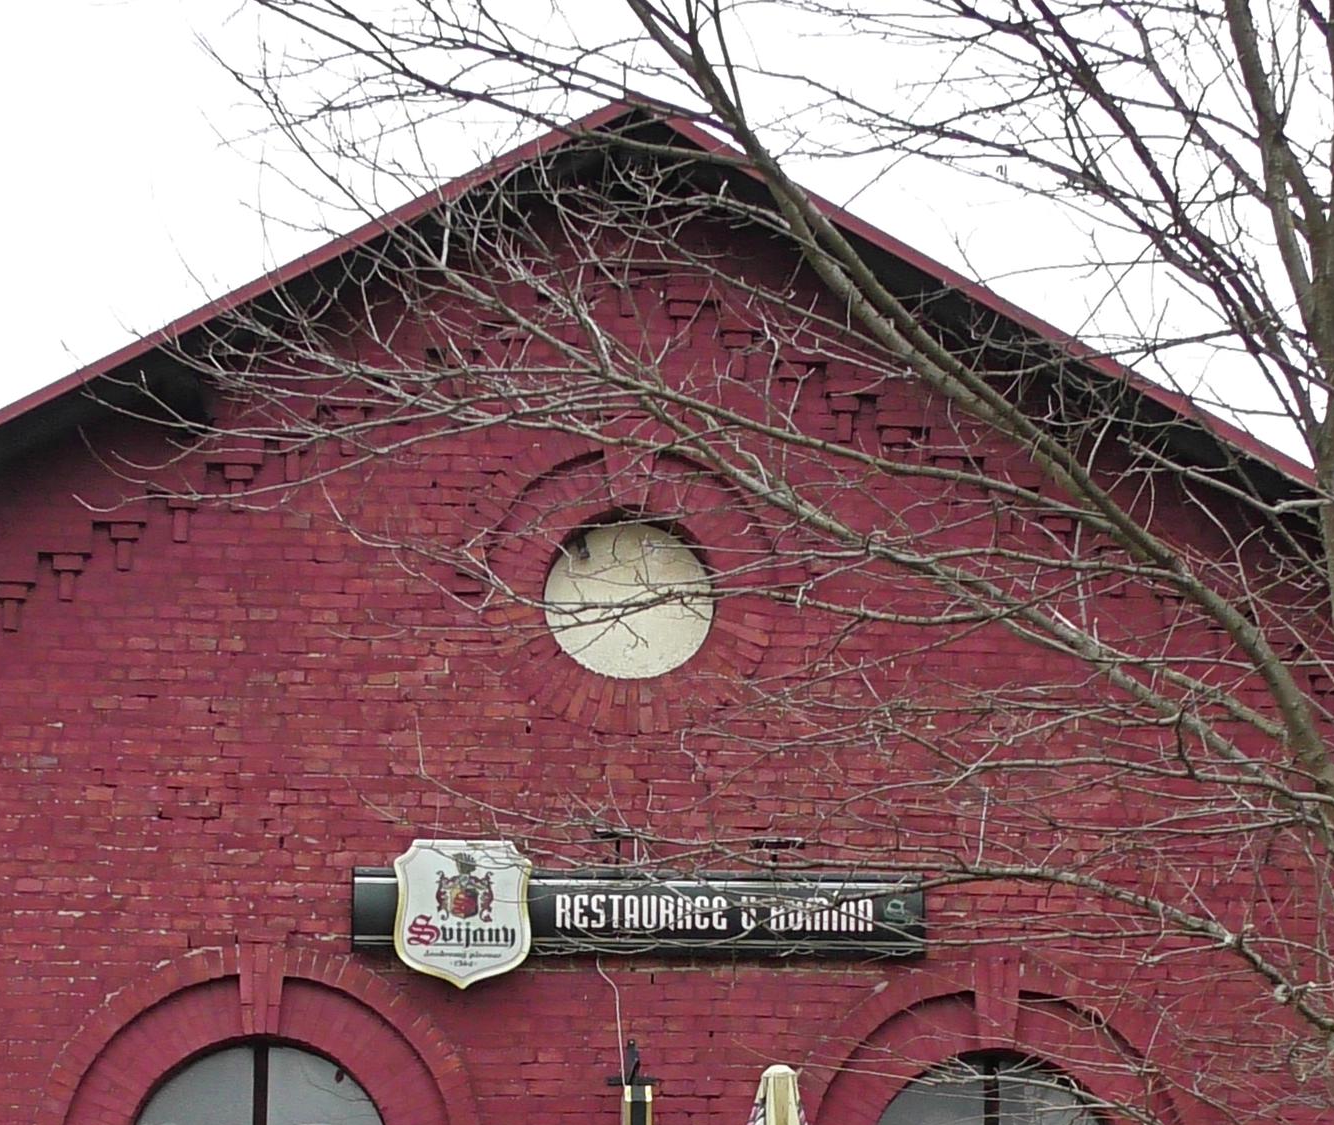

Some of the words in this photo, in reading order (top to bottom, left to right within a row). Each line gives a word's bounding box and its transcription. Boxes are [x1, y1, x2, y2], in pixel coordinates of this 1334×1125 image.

[555, 893, 728, 931] RESTAURACE
[740, 895, 758, 930] U
[407, 914, 516, 948] Svijany
